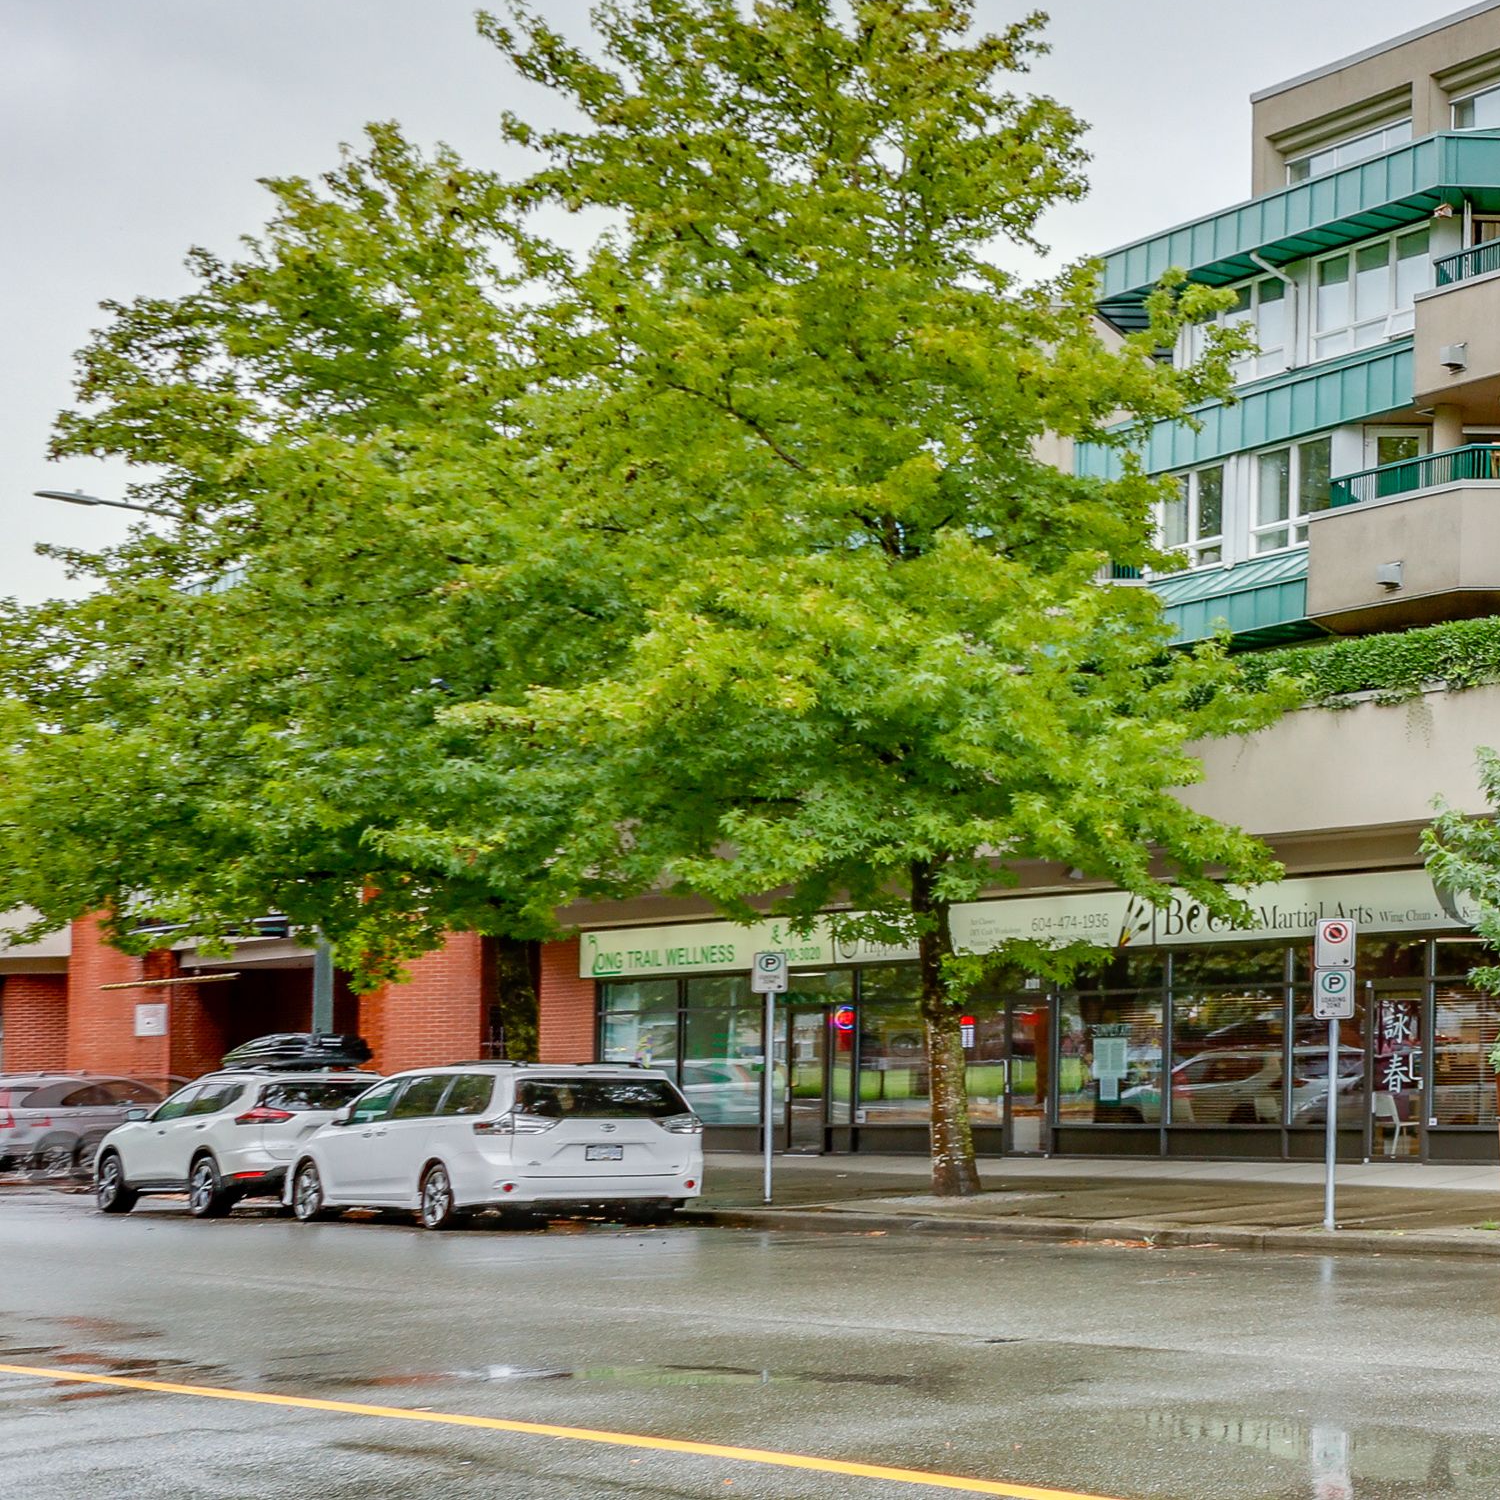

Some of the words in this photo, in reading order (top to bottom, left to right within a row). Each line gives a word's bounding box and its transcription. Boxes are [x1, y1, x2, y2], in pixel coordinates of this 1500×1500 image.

[1031, 913, 1110, 932] 604-474-1936
[1258, 901, 1325, 931] Martial
[1334, 901, 1373, 925] Arts
[627, 948, 662, 969] TRAIL
[666, 944, 735, 967] WELLNESS
[765, 957, 776, 968] P
[1329, 976, 1341, 989] P
